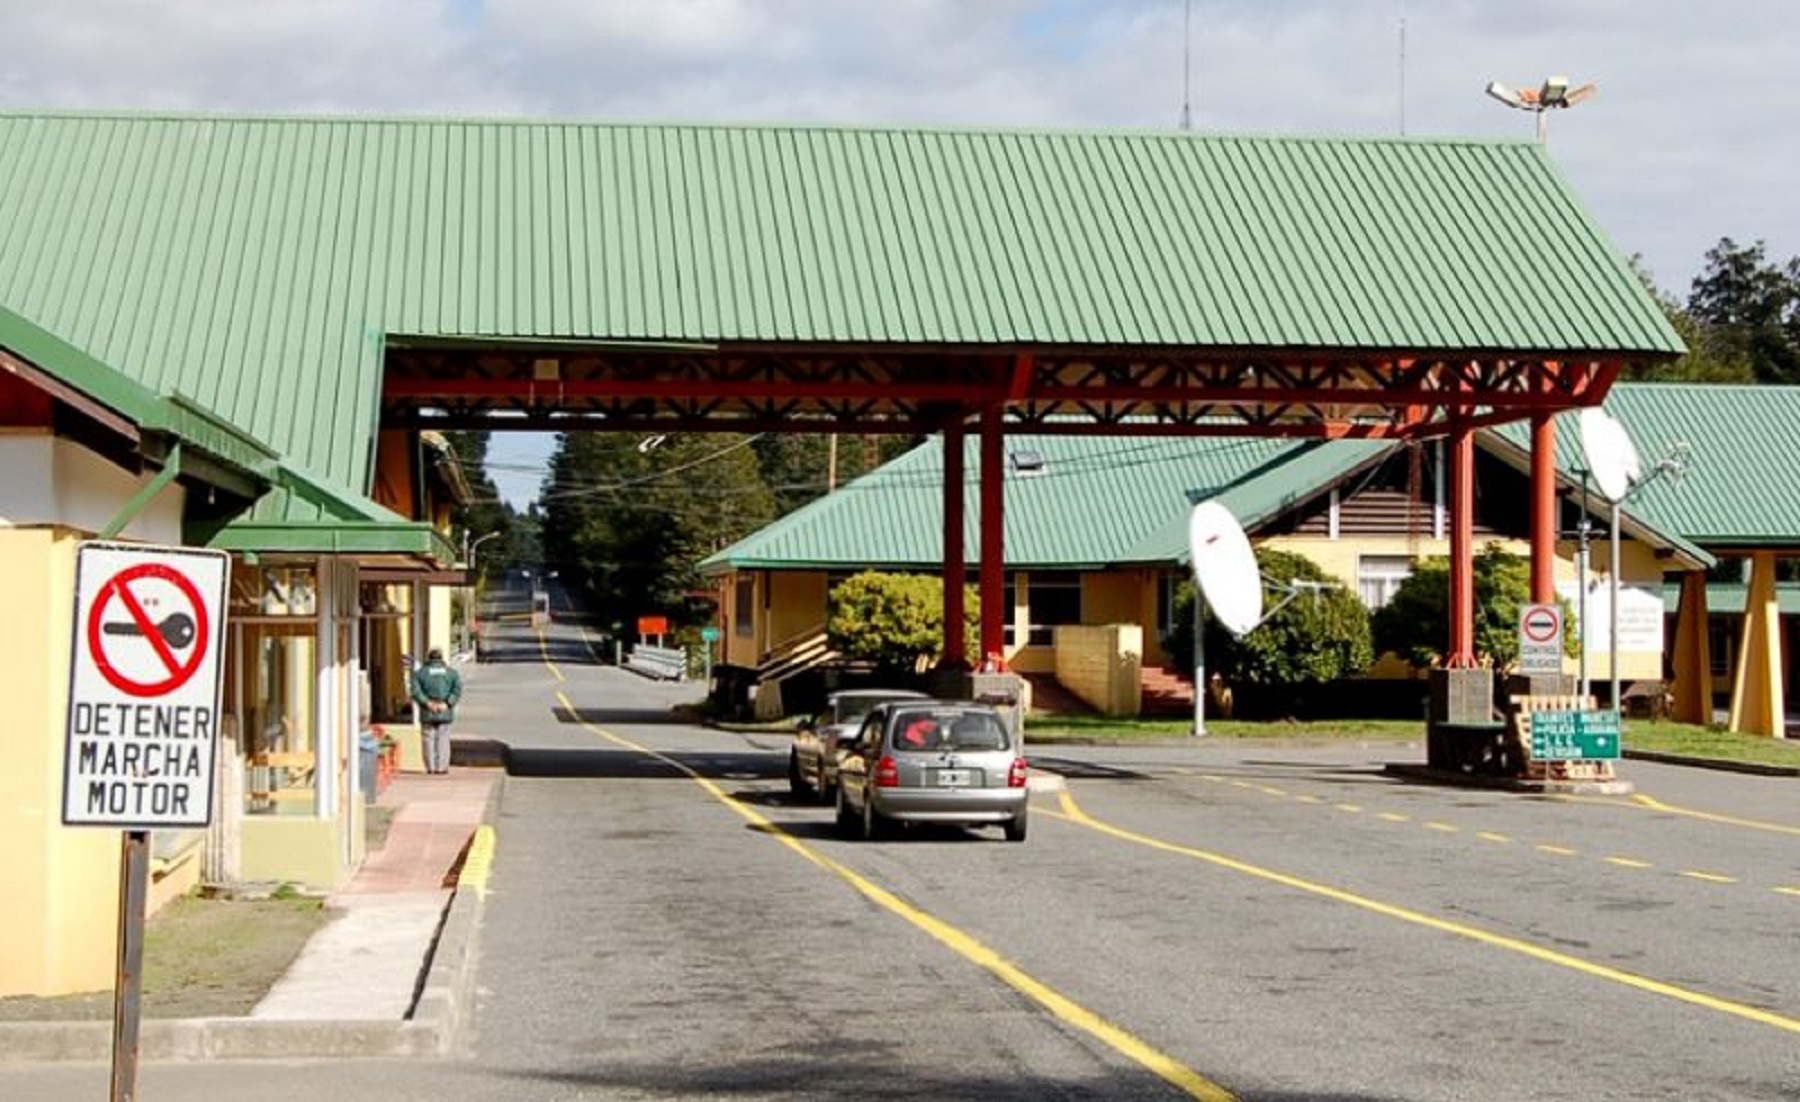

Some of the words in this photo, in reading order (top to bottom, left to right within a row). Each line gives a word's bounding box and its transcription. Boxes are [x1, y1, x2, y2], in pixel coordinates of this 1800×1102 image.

[74, 703, 210, 739] DETENER
[79, 741, 200, 778] MARCHA
[87, 781, 190, 815] MOTOR
